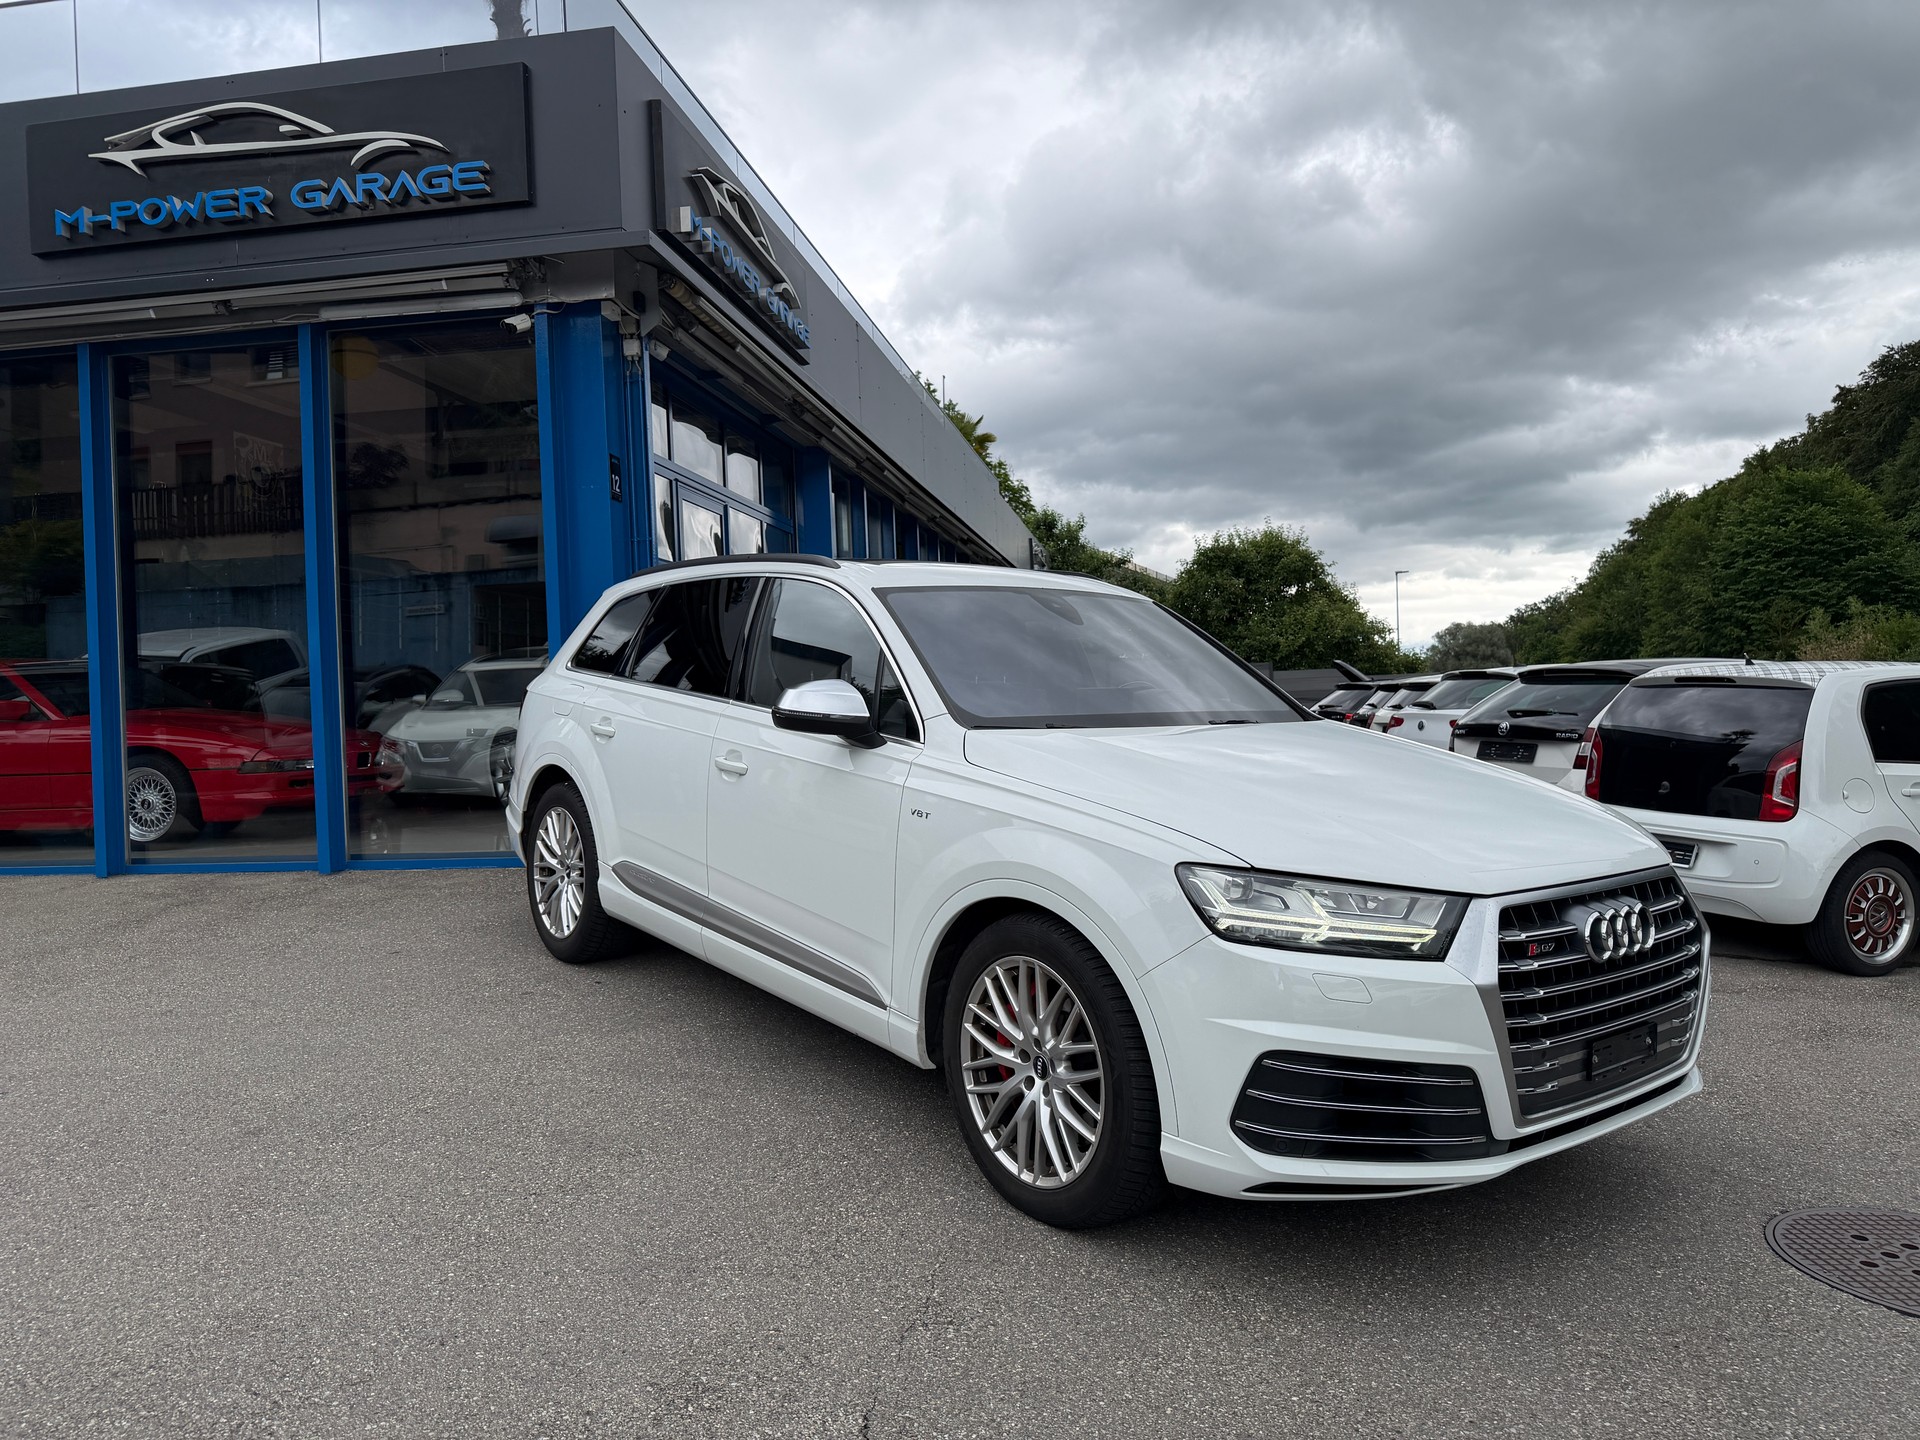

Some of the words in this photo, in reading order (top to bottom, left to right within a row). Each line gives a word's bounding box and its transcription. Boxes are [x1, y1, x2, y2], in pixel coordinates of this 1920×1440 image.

[54, 186, 270, 236] M-POWER
[290, 160, 486, 210] GARAGE
[765, 287, 811, 348] GARAGE
[611, 474, 621, 492] 12
